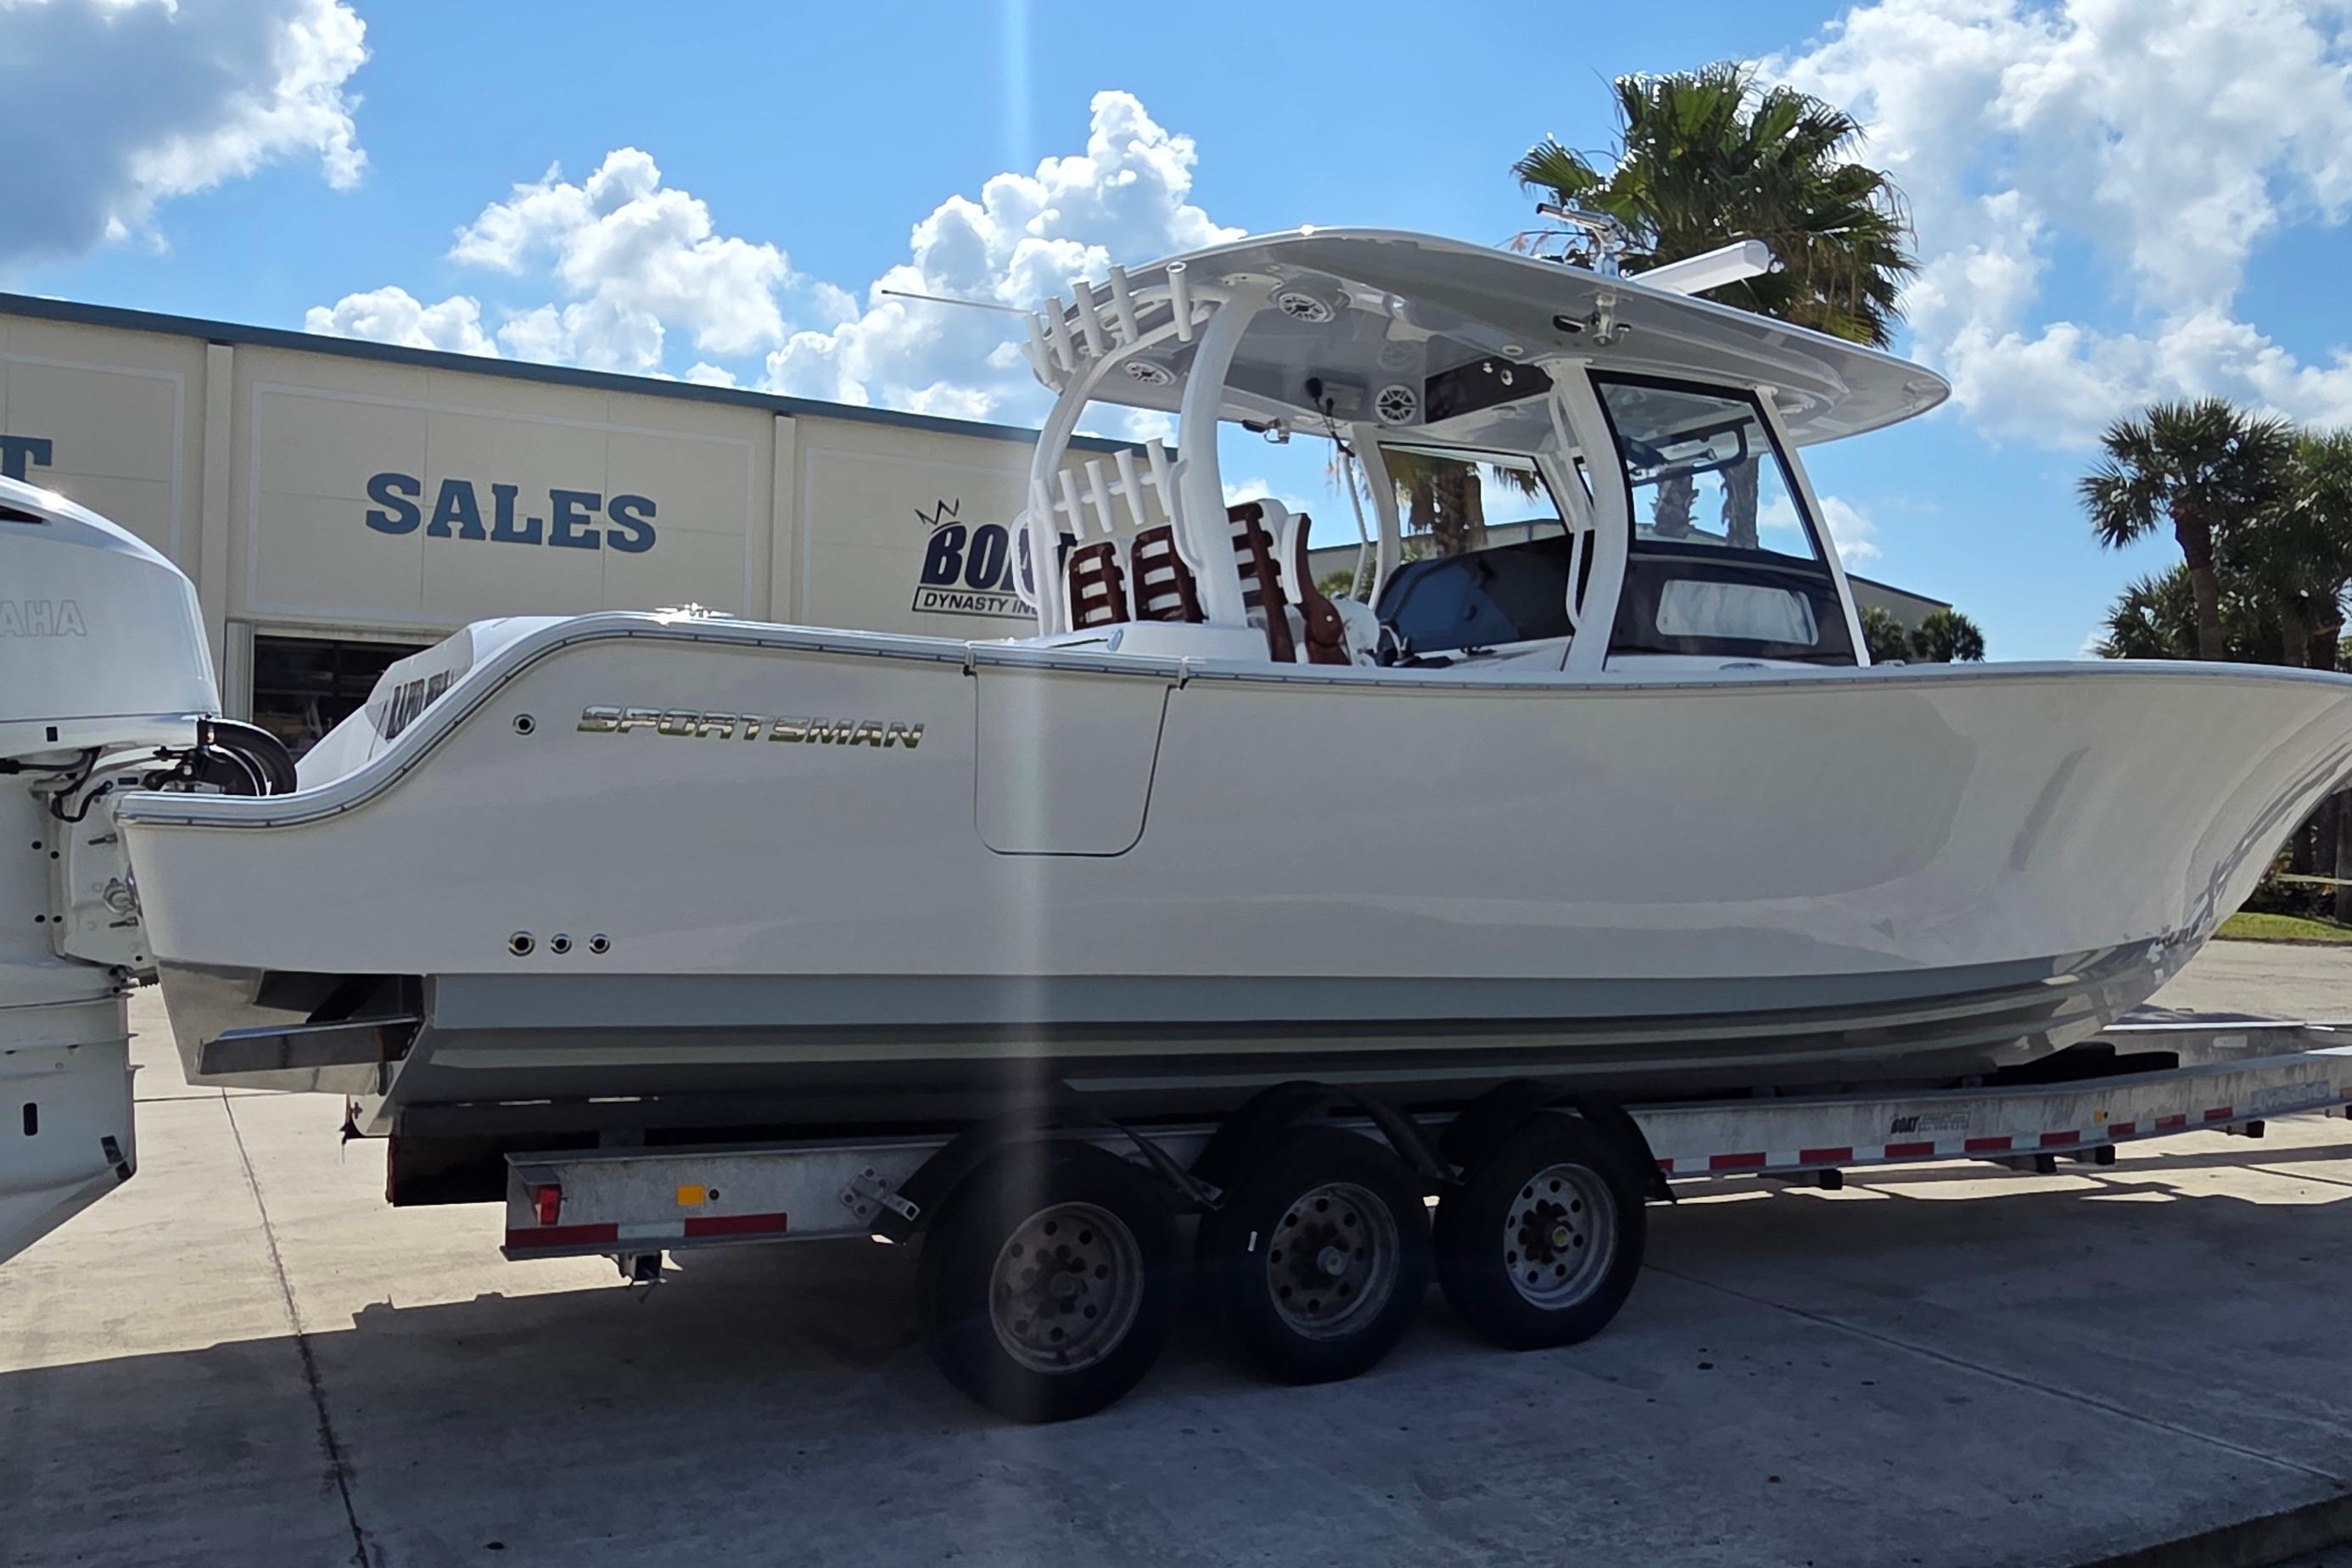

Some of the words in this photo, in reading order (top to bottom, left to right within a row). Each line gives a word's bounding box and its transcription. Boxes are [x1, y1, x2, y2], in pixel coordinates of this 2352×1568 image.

[366, 472, 657, 553] SALES
[924, 592, 1008, 612] DYNASTY
[577, 704, 925, 748] SPORTSMAN
